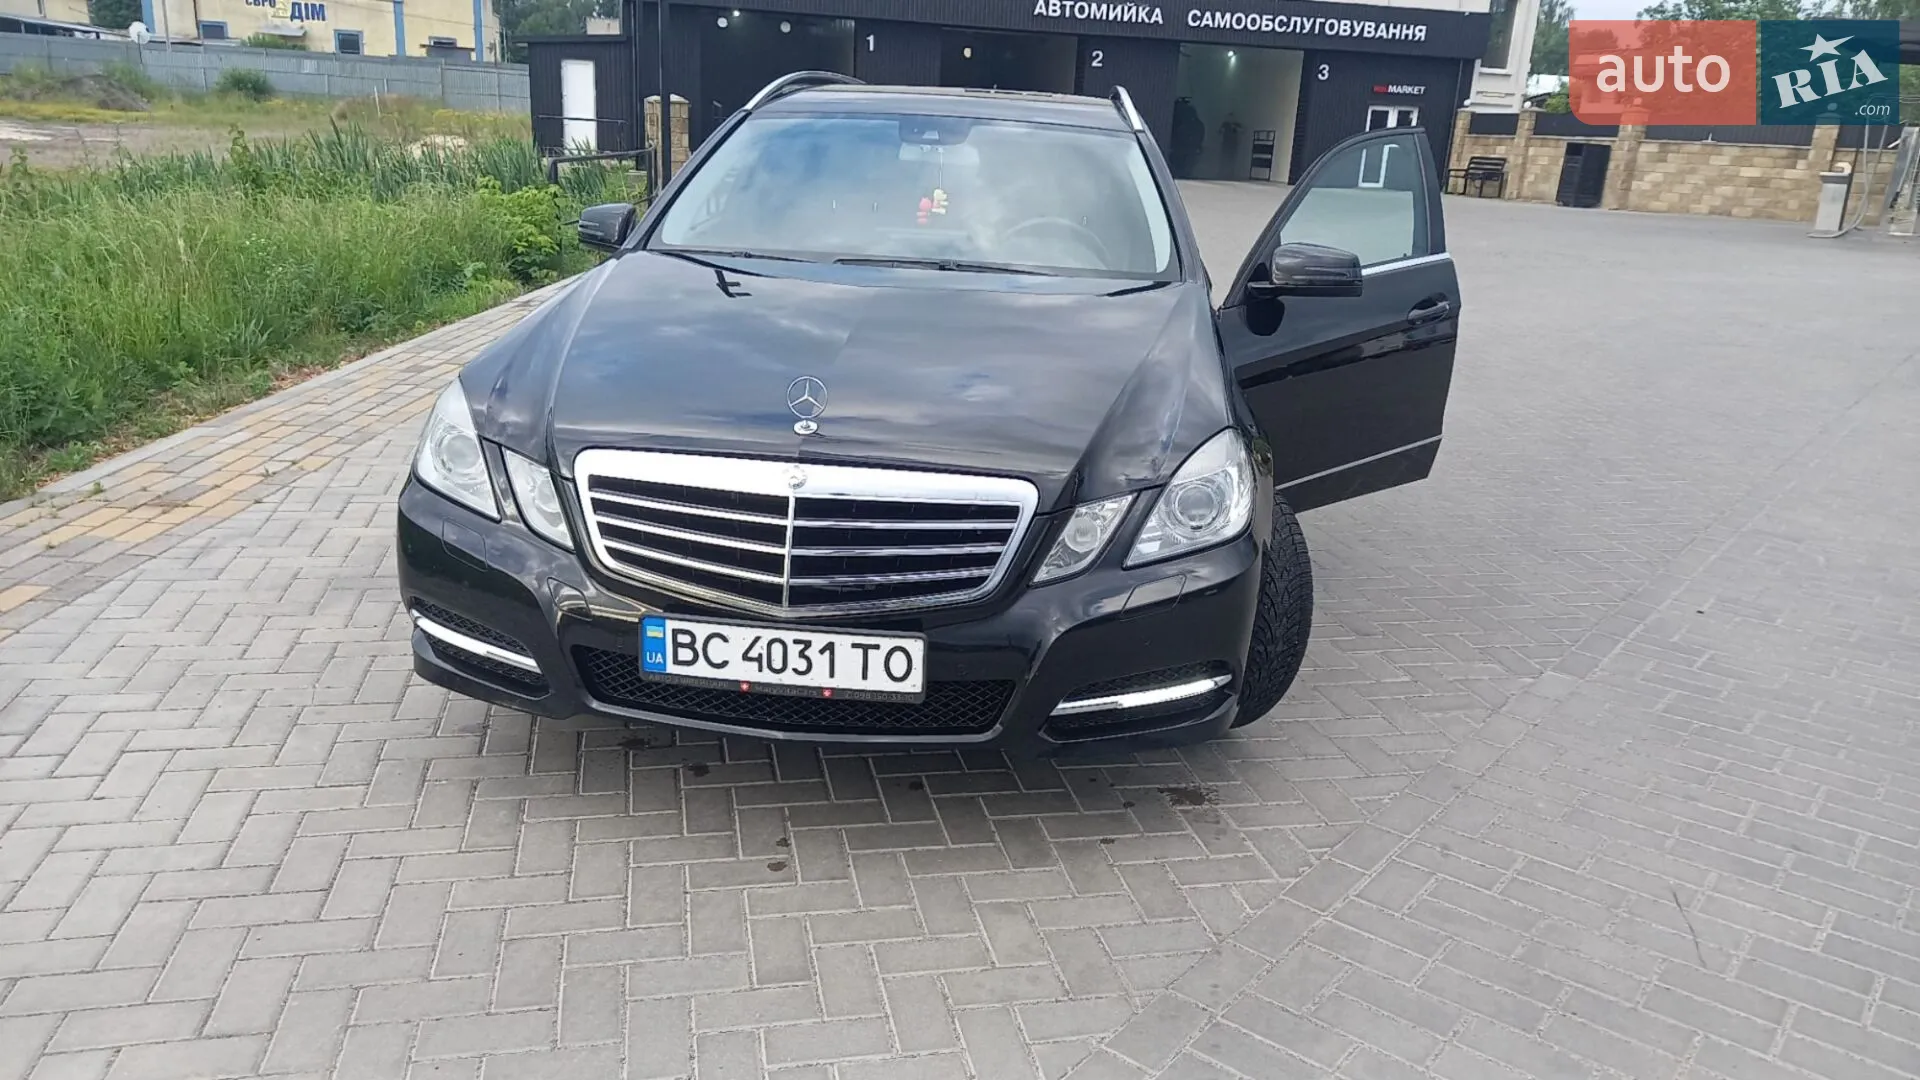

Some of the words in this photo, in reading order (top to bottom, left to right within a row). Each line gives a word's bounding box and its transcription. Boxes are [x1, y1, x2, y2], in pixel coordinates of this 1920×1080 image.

[290, 2, 326, 22] ДІМ
[1033, 0, 1163, 25] АВТОМИЙКА
[1187, 10, 1427, 42] САМООБСЛУГОВУВАННЯ
[866, 34, 876, 52] 1
[1091, 50, 1104, 68] 2
[1317, 64, 1330, 81] 3
[646, 651, 664, 664] UA
[671, 628, 730, 670] BC
[741, 635, 836, 679] 4031
[850, 642, 913, 683] TO
